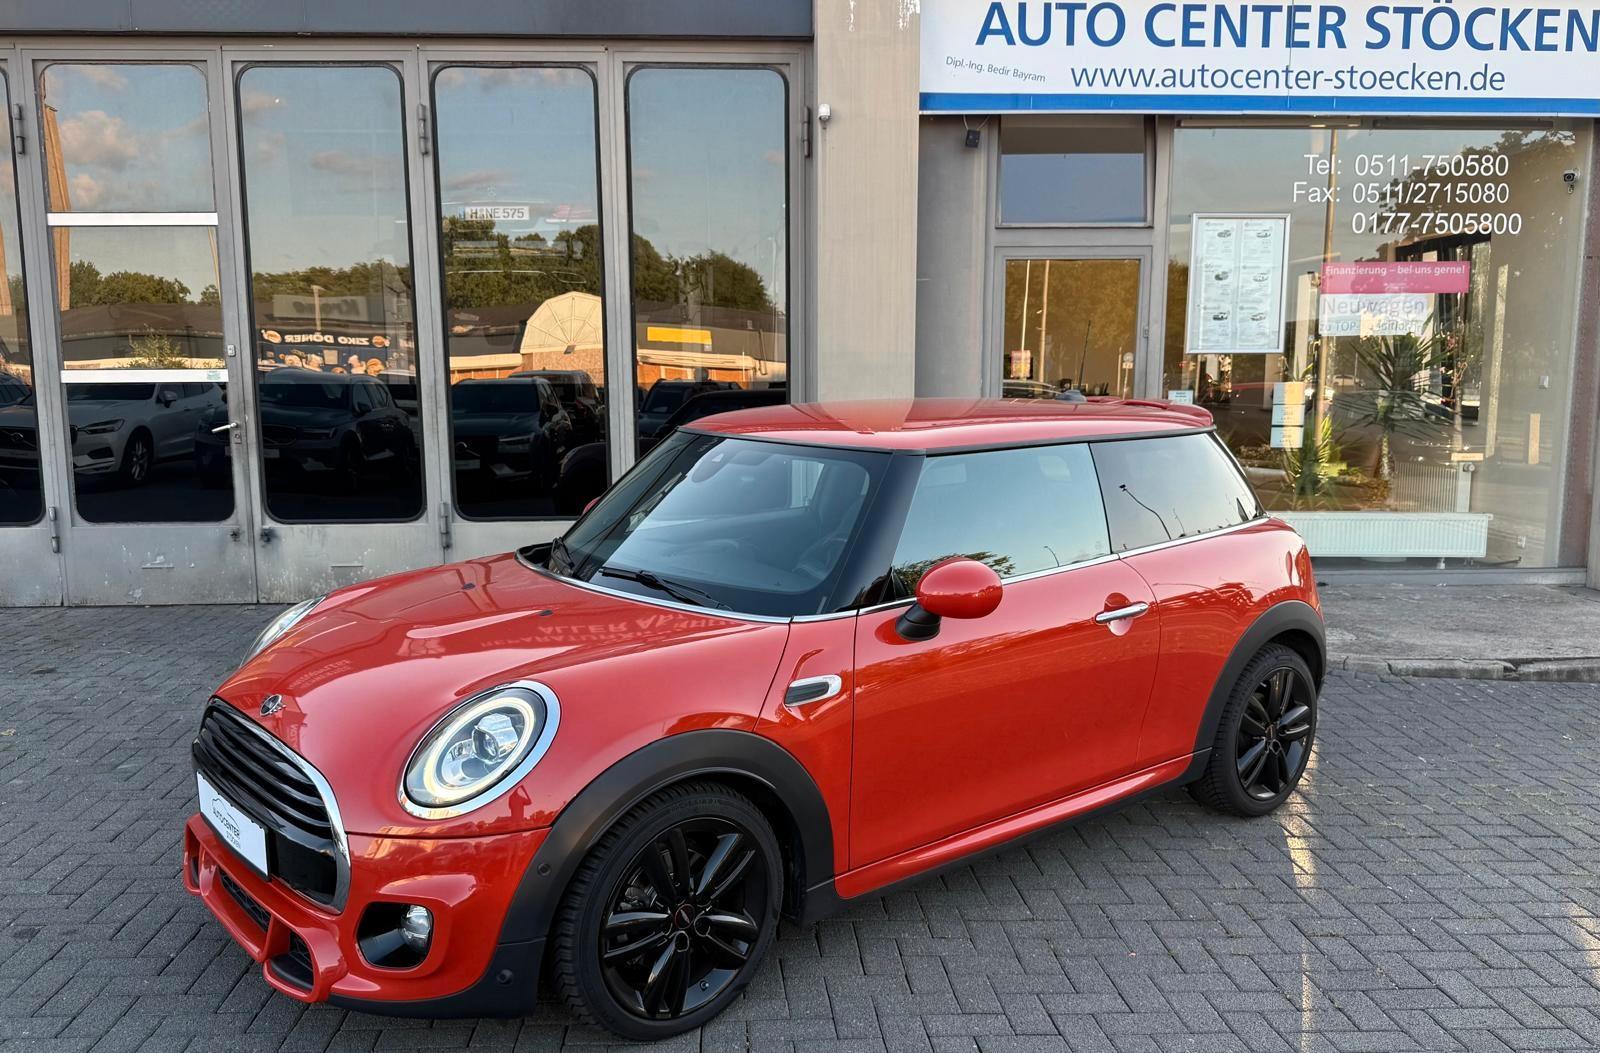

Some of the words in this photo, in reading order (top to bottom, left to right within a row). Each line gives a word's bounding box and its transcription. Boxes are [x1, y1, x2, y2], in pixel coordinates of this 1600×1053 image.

[975, 2, 1126, 47] AUTO
[1144, 3, 1347, 49] CENTER
[1365, 0, 1600, 52] STÖCKEN
[946, 56, 985, 73] Dipl.-Ing.
[987, 63, 1011, 76] Bedir
[1013, 68, 1046, 82] Bayram
[1070, 63, 1505, 91] www.autocenter-stoecken.de
[1304, 154, 1342, 175] Tel:
[1355, 154, 1509, 177] 0511-750580
[1293, 182, 1341, 203] Fax:
[1352, 182, 1510, 204] 0511/2715080
[1352, 212, 1522, 235] 0177-7505800
[1325, 265, 1387, 277] Finanzierung
[1415, 266, 1431, 275] uns
[1434, 265, 1466, 277] gerne!
[1322, 297, 1425, 318] Neuwagen
